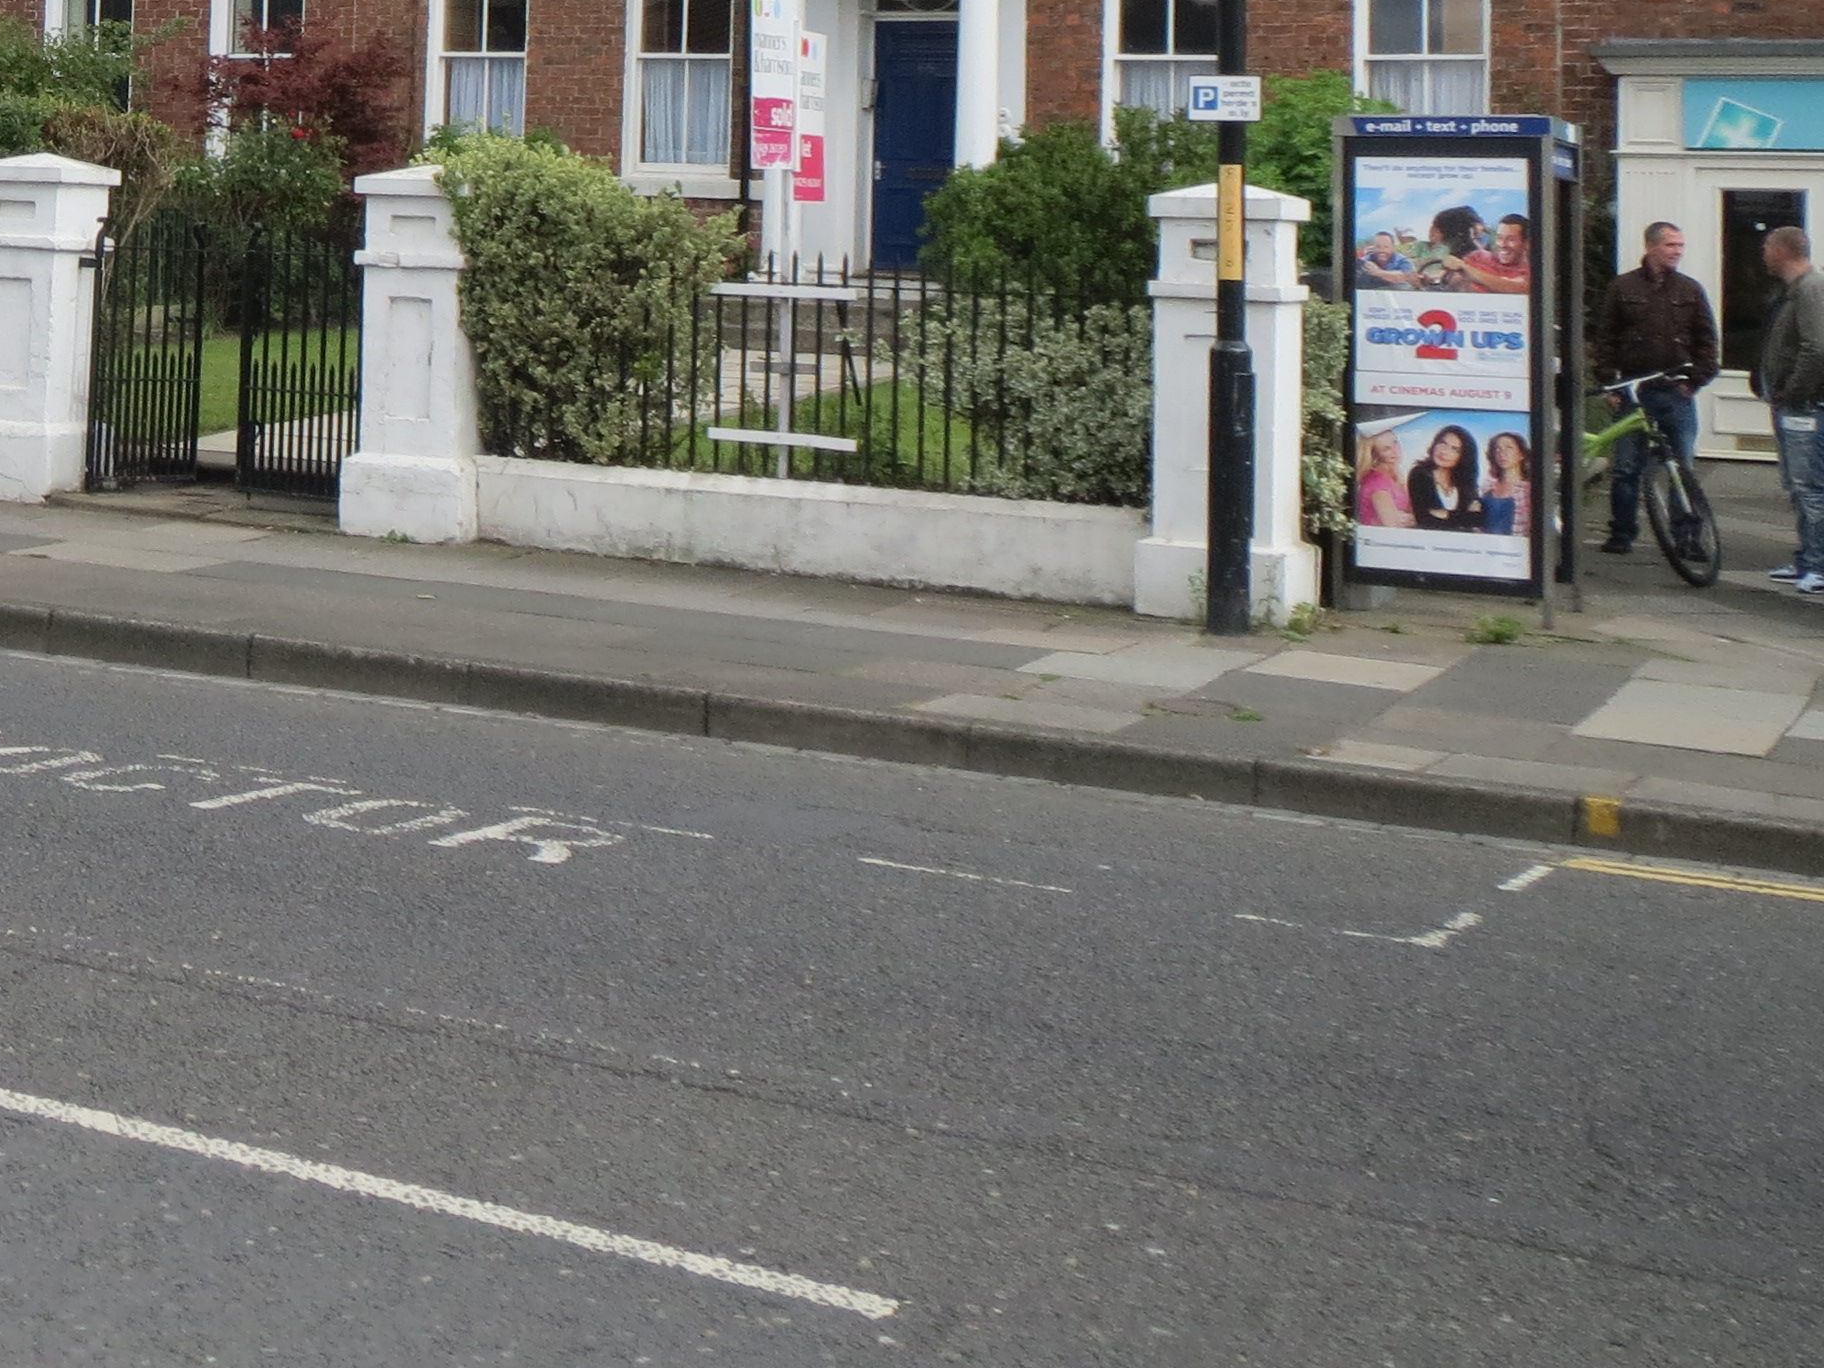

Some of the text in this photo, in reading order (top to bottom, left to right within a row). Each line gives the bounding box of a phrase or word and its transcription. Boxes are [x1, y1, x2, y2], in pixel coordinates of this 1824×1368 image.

[1198, 88, 1215, 108] P
[1221, 99, 1257, 107] hodes
[770, 102, 793, 127] sold
[1365, 119, 1519, 134] e-mail text phone
[1366, 326, 1524, 350] GROWN UPS
[1416, 309, 1459, 360] 2
[1371, 385, 1512, 400] AT CINEMAS AUGUST 9
